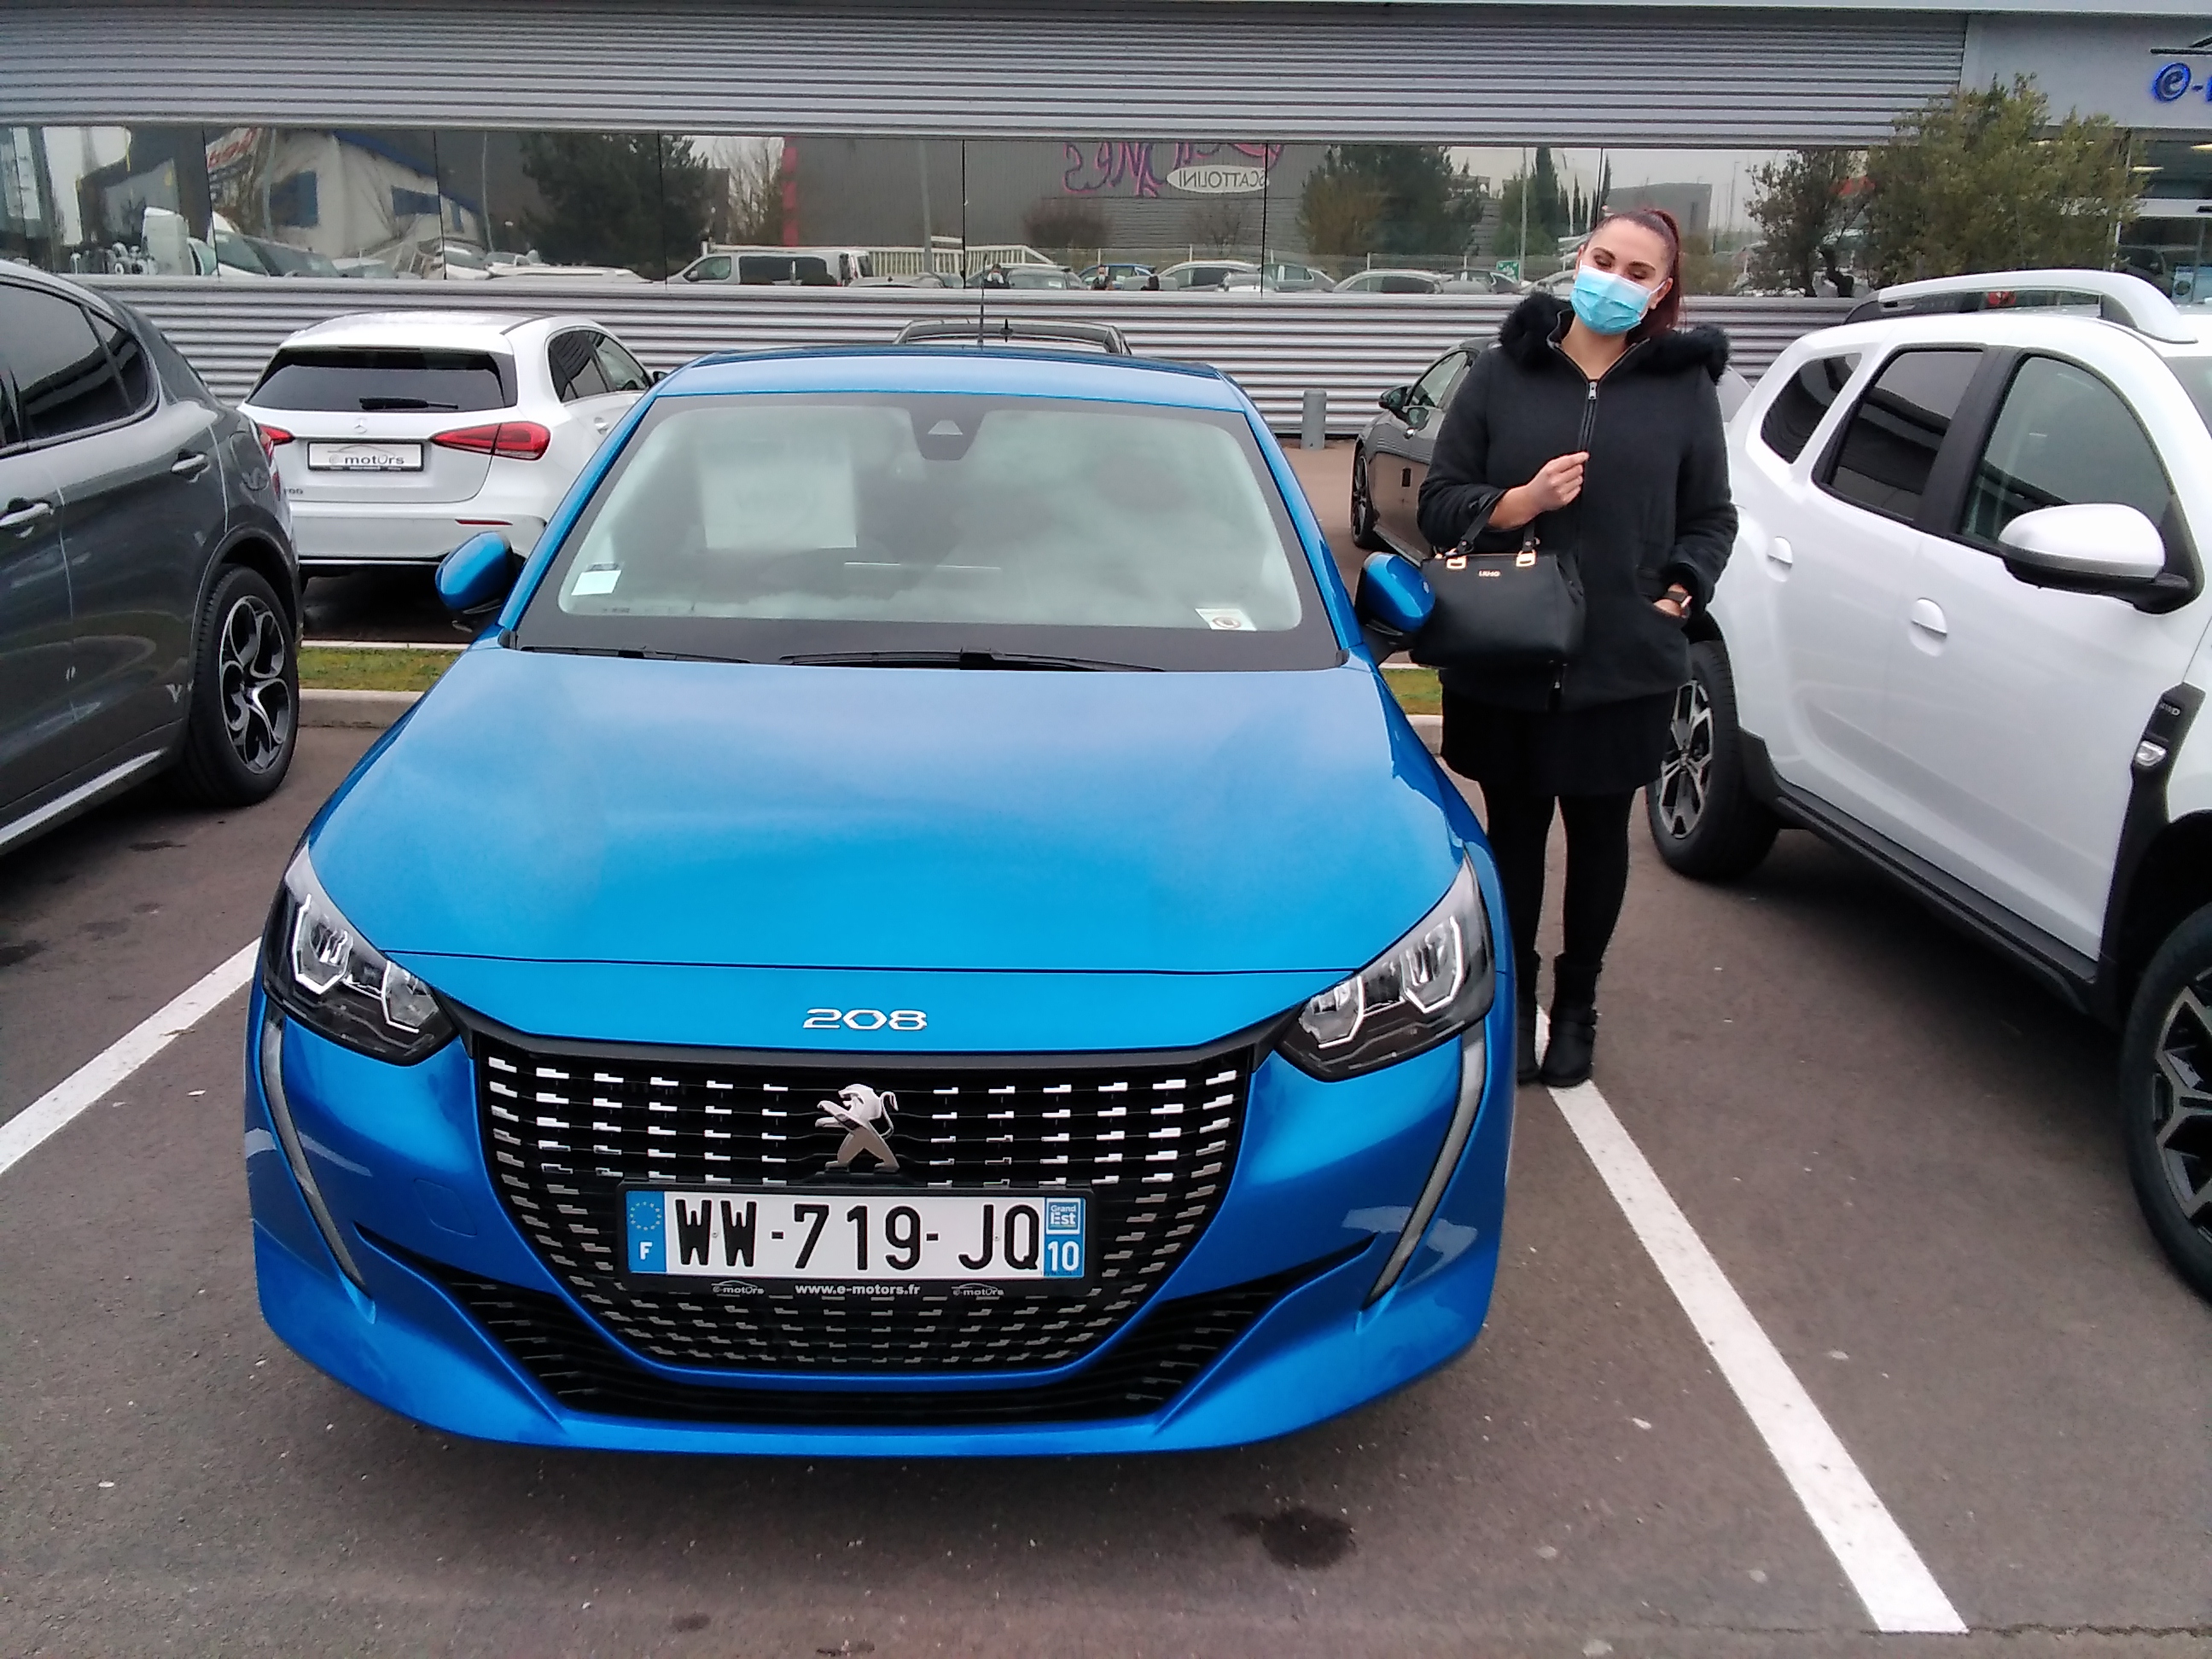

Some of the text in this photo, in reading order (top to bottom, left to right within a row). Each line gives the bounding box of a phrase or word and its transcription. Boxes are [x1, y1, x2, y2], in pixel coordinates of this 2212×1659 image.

[802, 1008, 928, 1031] 208
[1050, 1204, 1077, 1213] Grand
[1050, 1212, 1076, 1225] Est
[640, 1242, 653, 1260] F
[1047, 1241, 1080, 1272] 10
[795, 1284, 921, 1295] www.e-motors.fr
